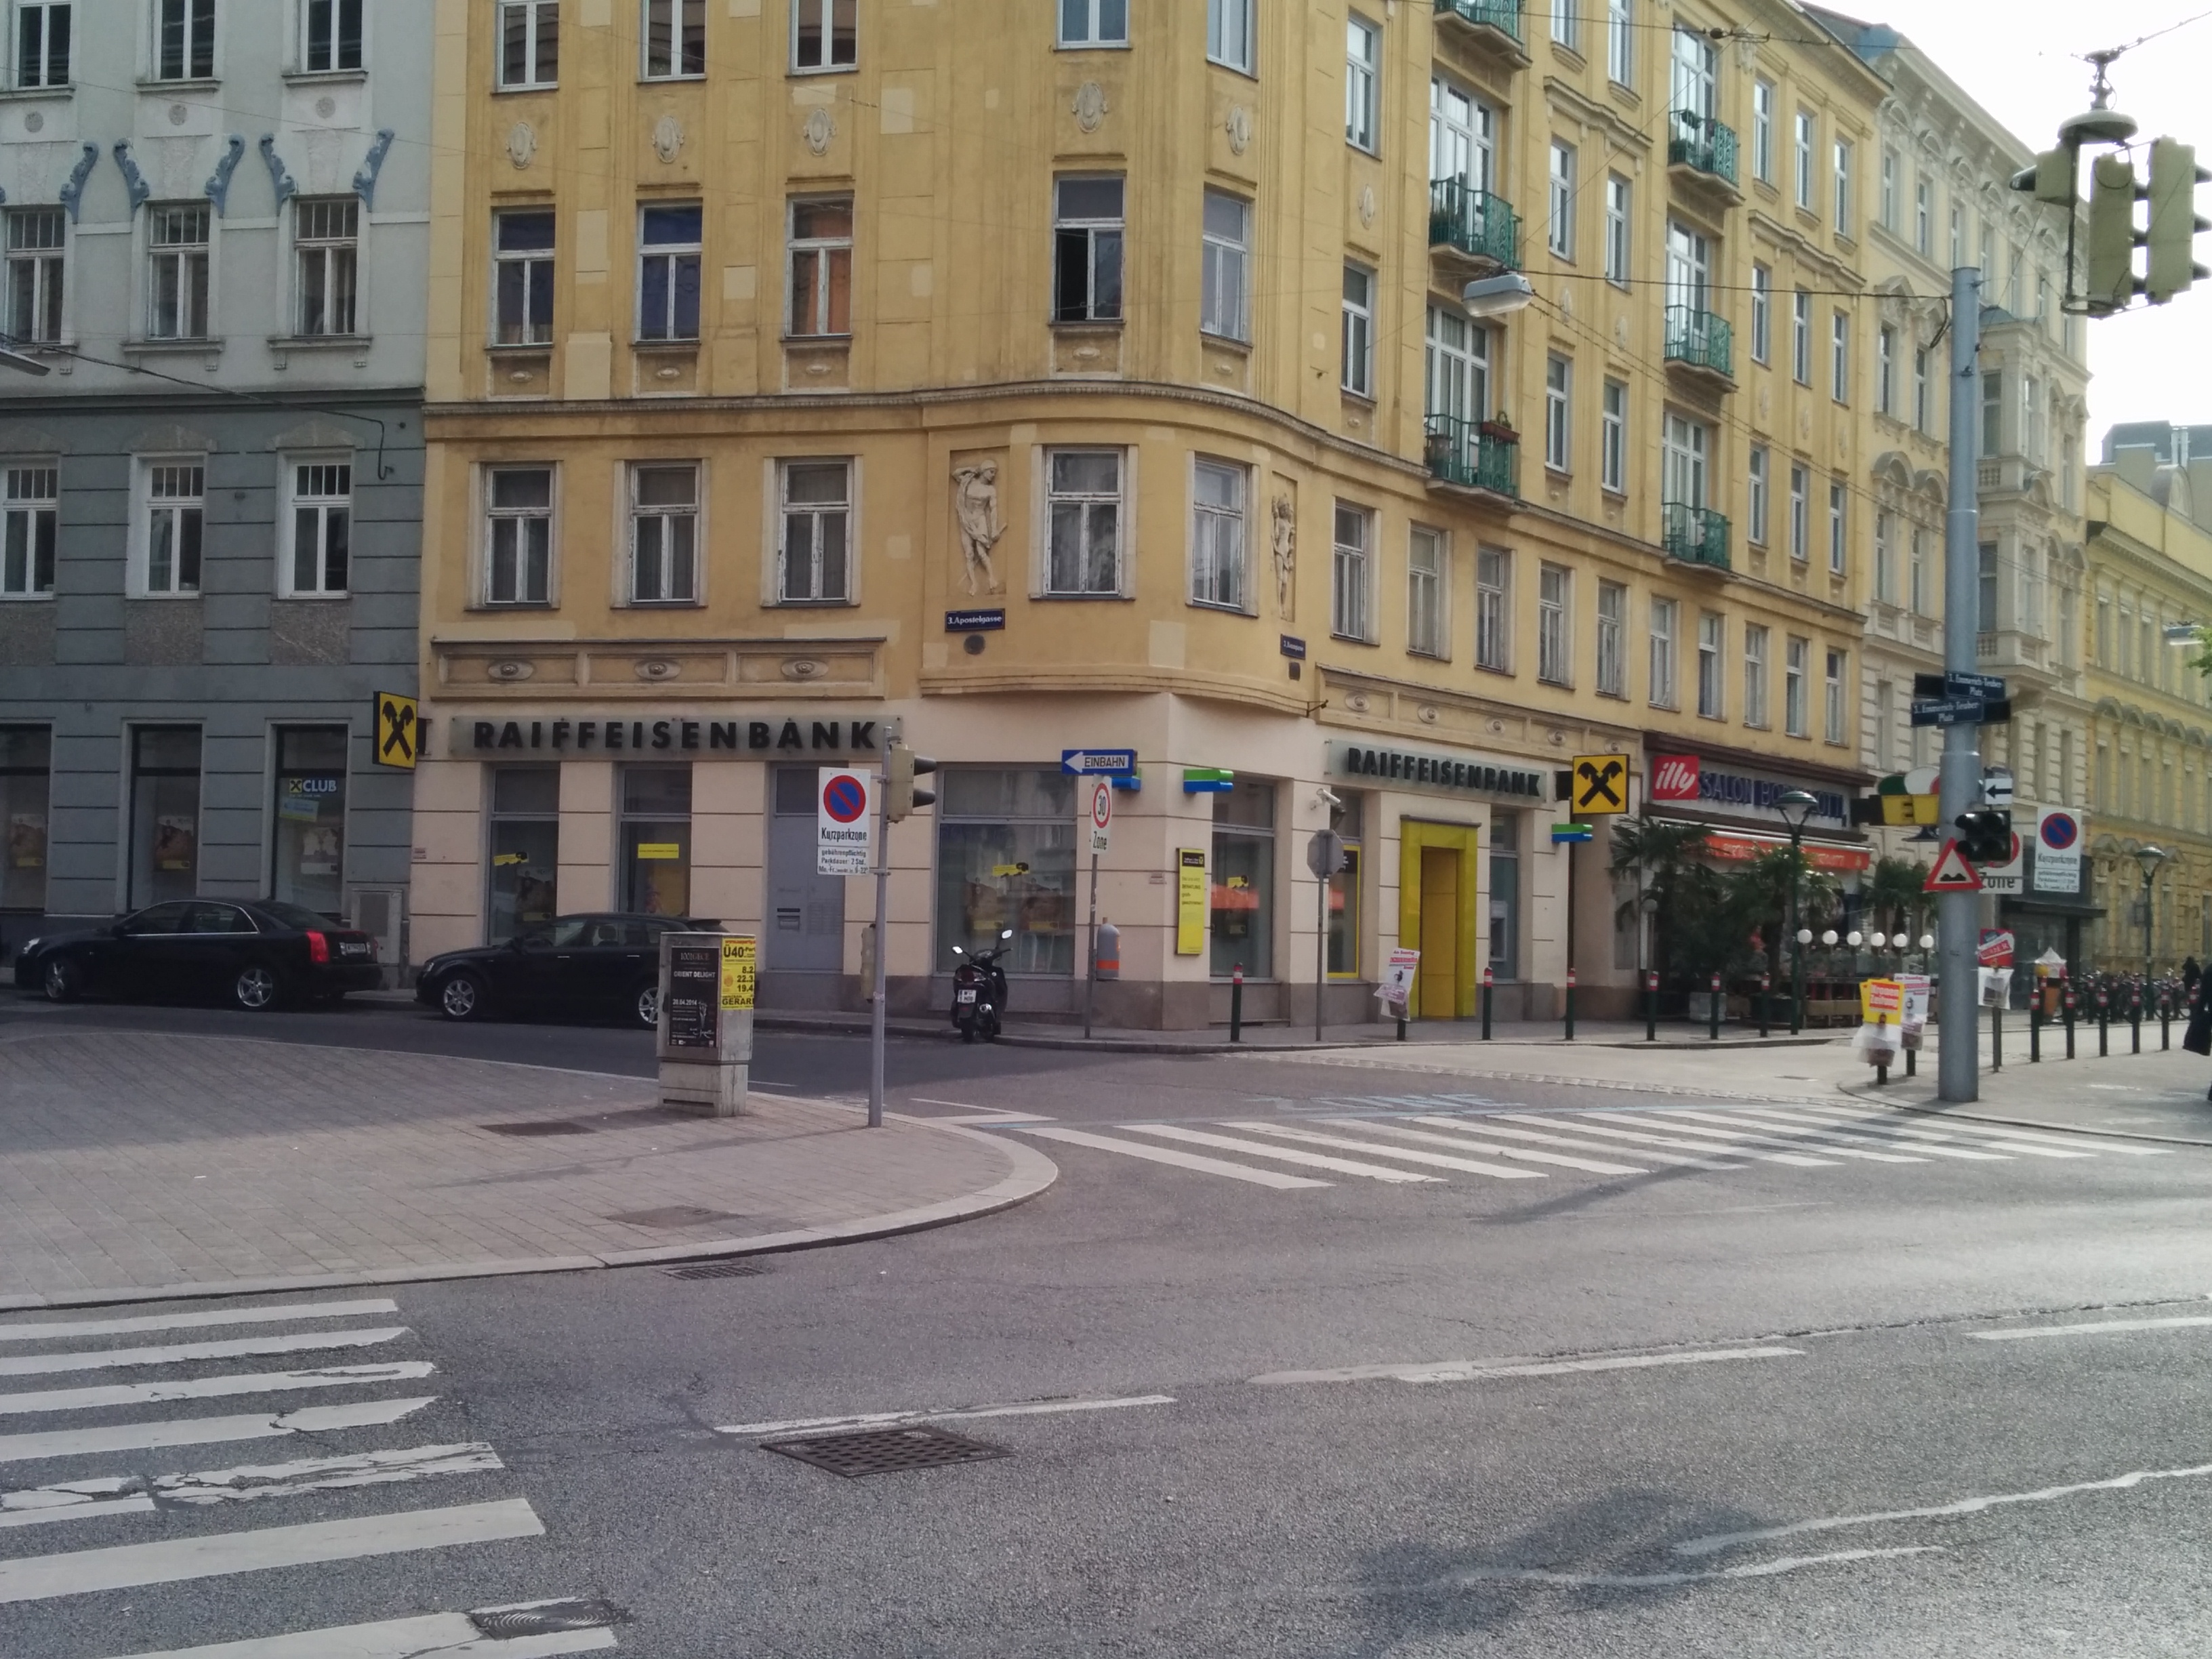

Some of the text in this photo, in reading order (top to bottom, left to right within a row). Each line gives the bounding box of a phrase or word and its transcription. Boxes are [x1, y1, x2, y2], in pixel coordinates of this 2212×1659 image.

[474, 722, 876, 748] RAIFFEISENBANK
[1085, 756, 1125, 768] EINBAHN
[1349, 747, 1540, 796] RAIFFEISENBANK
[303, 780, 337, 792] CLUB
[1656, 762, 1696, 797] illy
[1098, 795, 1106, 816] 30
[821, 827, 867, 842] Kurzparkzone
[1093, 831, 1107, 851] Zone
